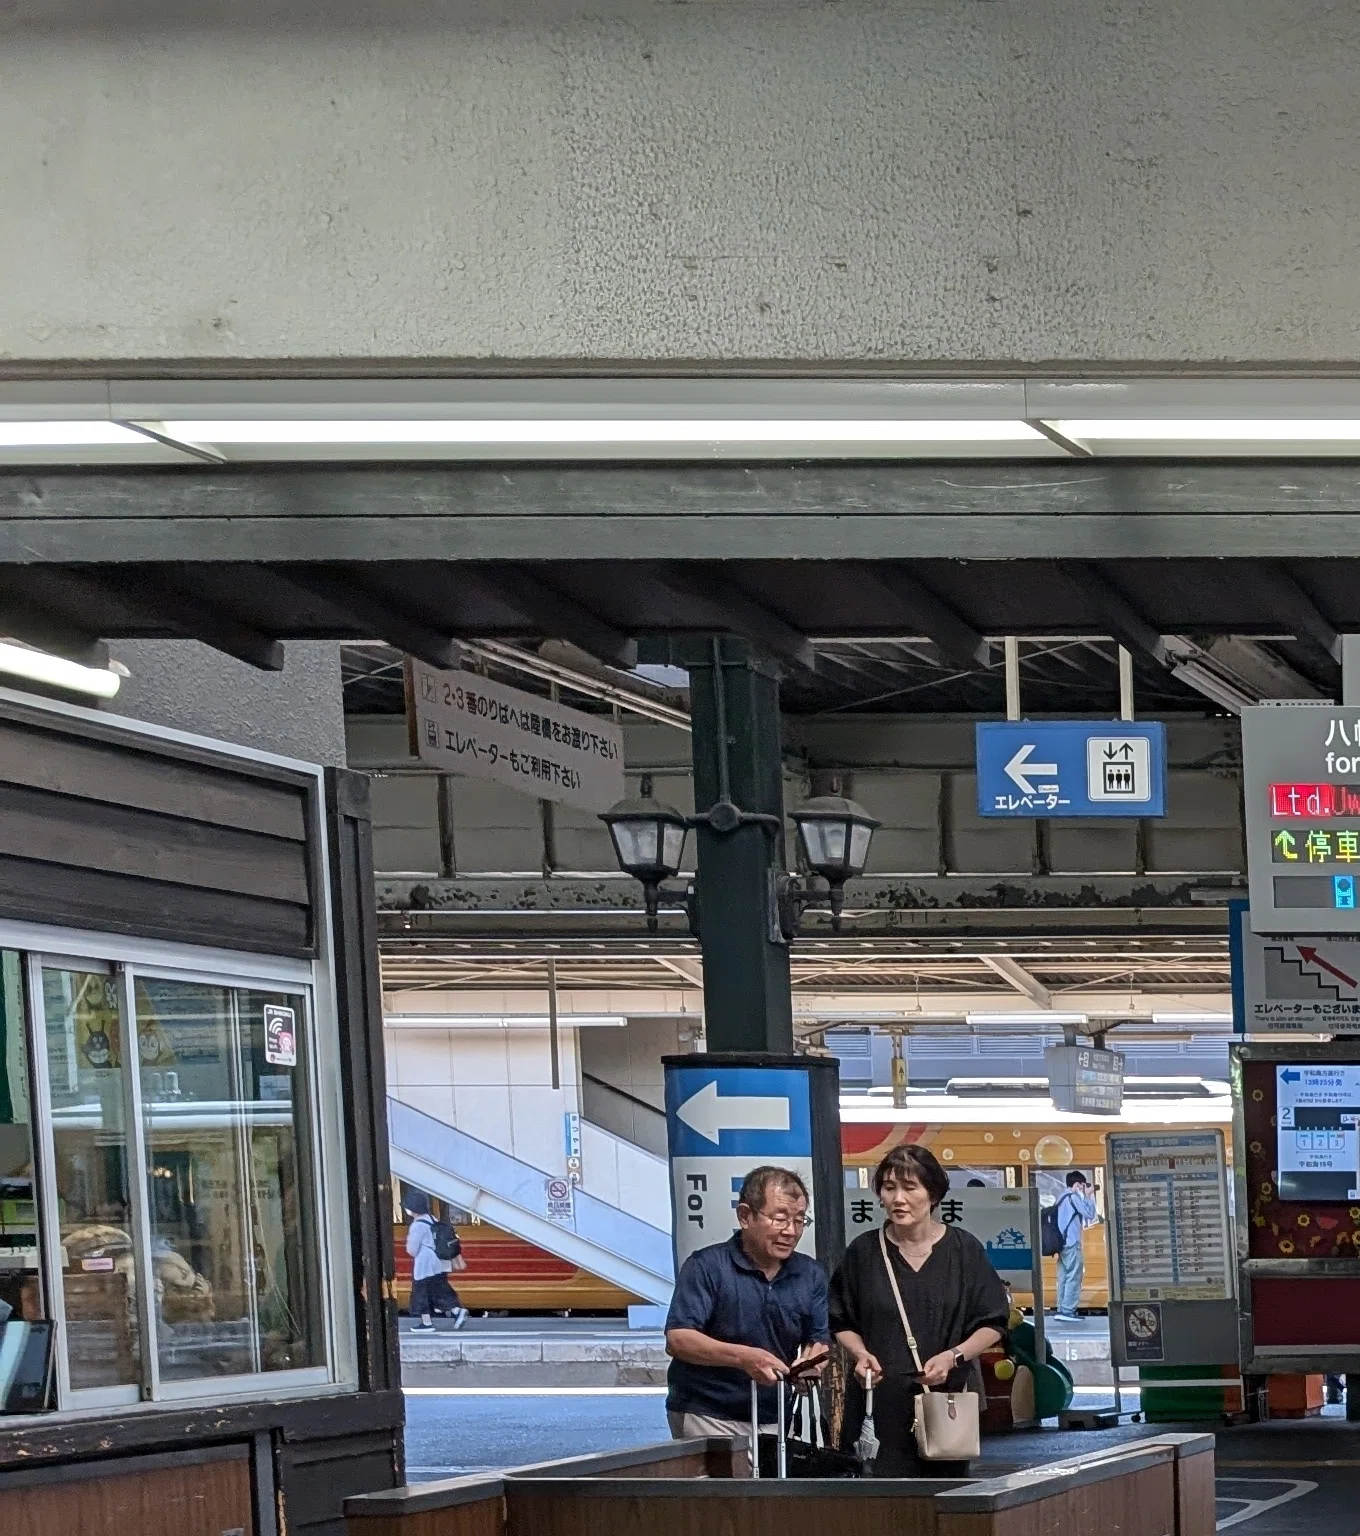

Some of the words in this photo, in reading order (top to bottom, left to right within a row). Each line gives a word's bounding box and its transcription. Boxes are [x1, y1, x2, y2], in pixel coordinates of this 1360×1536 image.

[1325, 752, 1360, 773] for
[995, 794, 1070, 810] エレベーター
[1272, 785, 1331, 816] Ltd.
[1282, 1107, 1291, 1120] 2
[686, 1174, 707, 1230] For
